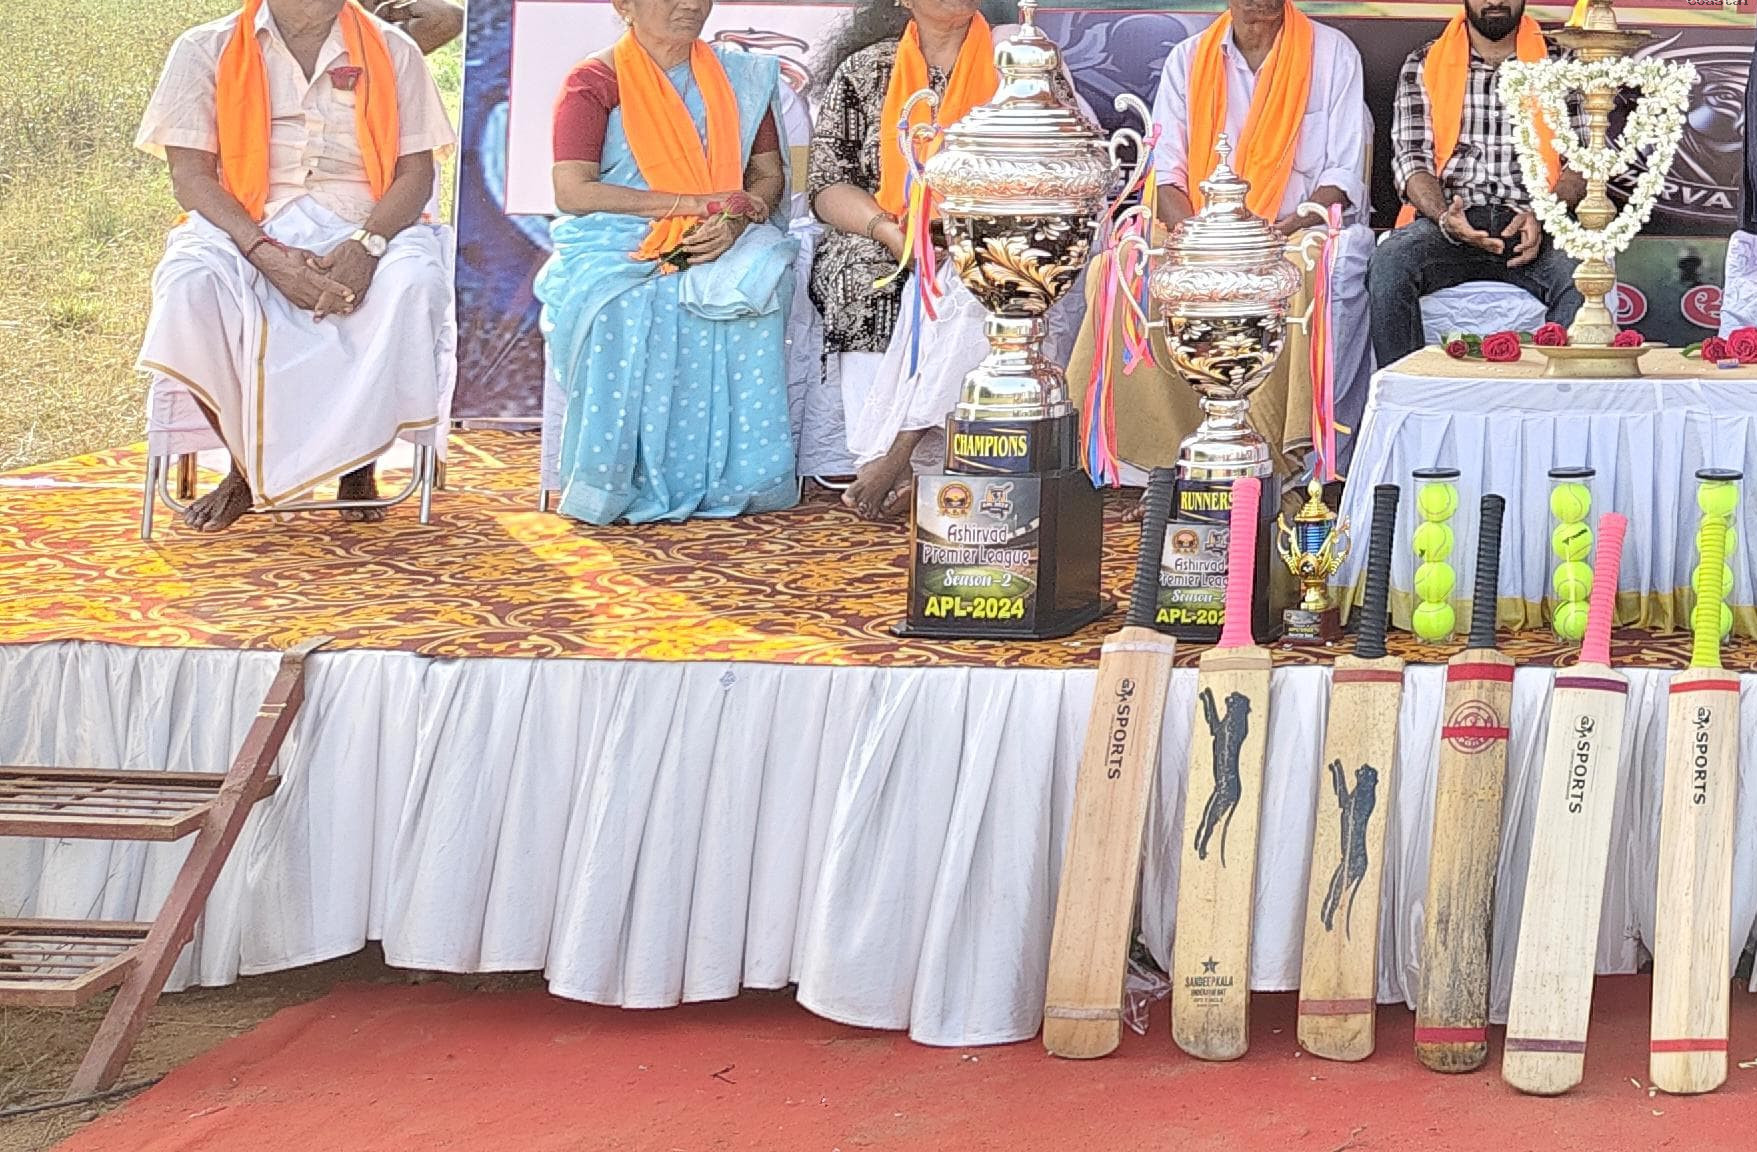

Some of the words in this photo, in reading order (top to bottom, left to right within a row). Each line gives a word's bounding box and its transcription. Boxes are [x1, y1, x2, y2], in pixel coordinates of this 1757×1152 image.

[954, 433, 1027, 458] CHAMPIONS
[947, 524, 1008, 544] Ashirvad
[922, 546, 977, 565] Premier
[979, 547, 1029, 569] League
[1175, 557, 1225, 572] Ashirvad
[924, 597, 1025, 620] APL-2024
[1156, 608, 1225, 625] APL-202
[1107, 704, 1131, 780] SPORTS
[1569, 741, 1591, 814] SPORTS
[1693, 731, 1709, 805] SPORTS
